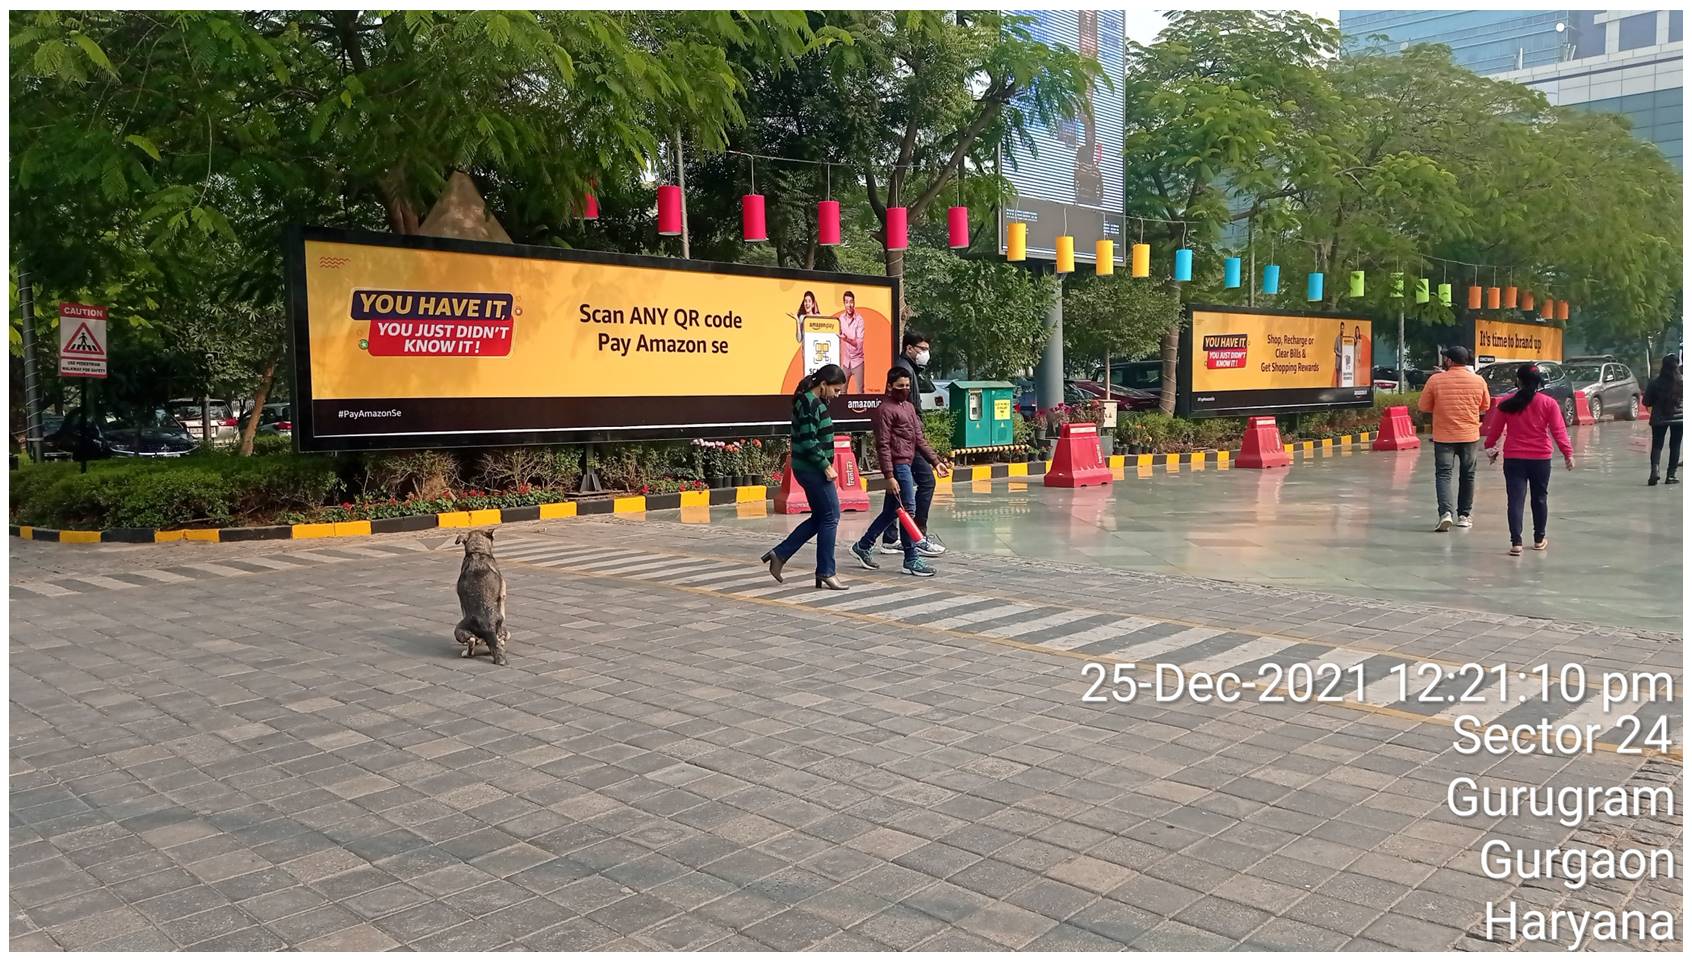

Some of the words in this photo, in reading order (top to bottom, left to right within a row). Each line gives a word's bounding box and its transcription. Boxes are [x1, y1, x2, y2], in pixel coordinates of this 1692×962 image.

[64, 306, 103, 317] CAUTION
[361, 293, 412, 314] YOU
[418, 296, 481, 317] HAVE
[485, 300, 507, 320] IT,
[579, 304, 624, 324] Scan
[629, 306, 668, 325] ANY
[674, 309, 700, 330] QR
[704, 311, 742, 329] code
[377, 322, 412, 337] YOU
[415, 323, 454, 338] JUST
[456, 325, 509, 339] DIDN'T
[404, 339, 455, 353] KNOW
[598, 333, 631, 357] Pay
[636, 334, 707, 353] Amazon
[711, 340, 729, 354] se
[1205, 337, 1220, 347] YOU
[1220, 337, 1239, 347] HAVE
[1267, 334, 1282, 346] Shop,
[1283, 334, 1307, 347] Recharge
[1308, 337, 1314, 345] or
[1480, 330, 1491, 347] It's
[1492, 333, 1507, 348] time
[1508, 334, 1515, 348] to
[1515, 333, 1533, 349] brand
[1534, 339, 1541, 353] up
[1275, 349, 1289, 359] Clear
[1289, 349, 1302, 359] Bills
[1302, 350, 1306, 358] &
[1260, 363, 1271, 372] Get
[1271, 362, 1297, 375] Shopping
[1298, 363, 1319, 372] Rewards
[338, 409, 402, 420] #PayAmazonSe
